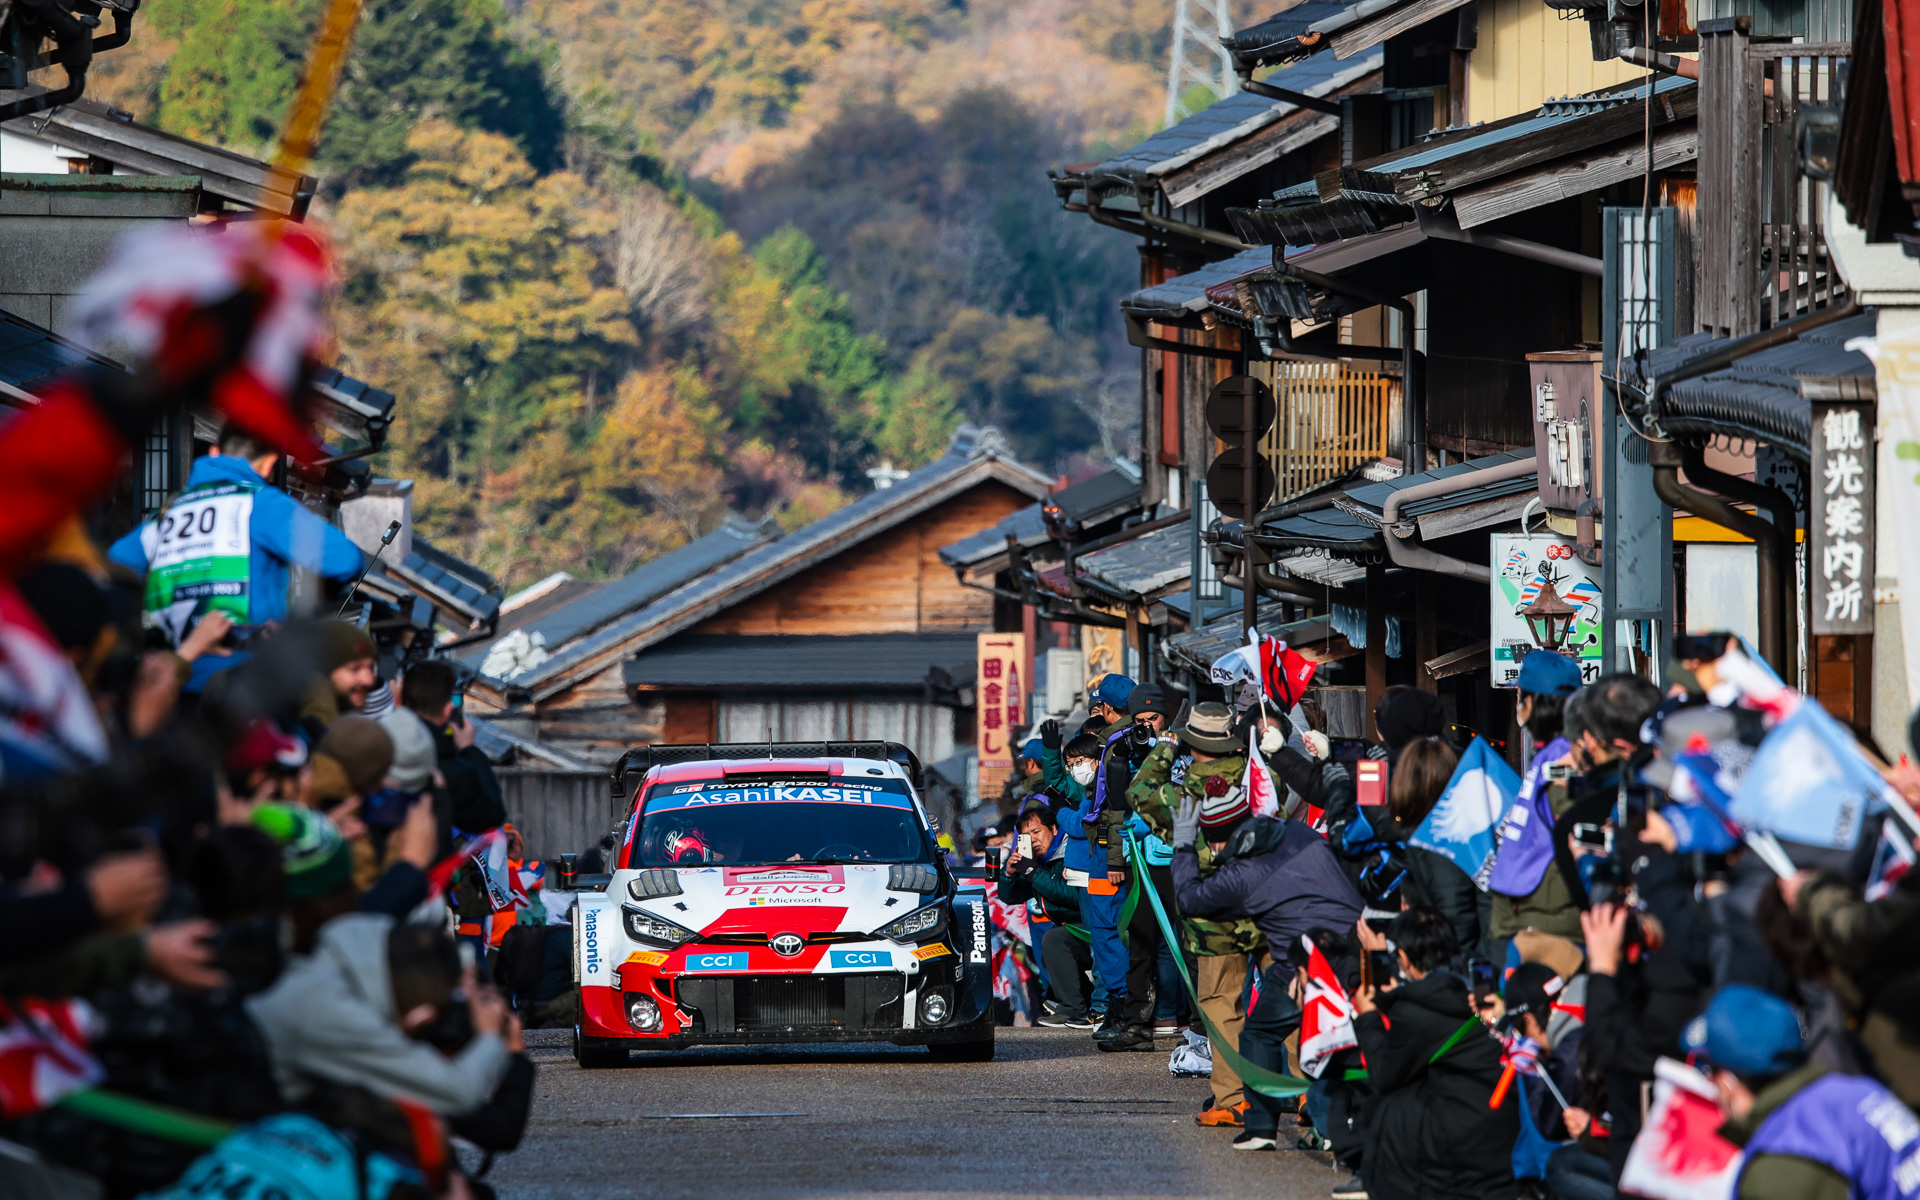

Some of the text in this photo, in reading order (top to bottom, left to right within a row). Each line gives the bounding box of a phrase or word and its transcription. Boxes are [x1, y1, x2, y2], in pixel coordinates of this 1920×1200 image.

[1823, 409, 1864, 622] 観光案内所
[161, 507, 216, 544] 220
[1547, 546, 1573, 557] 快適
[674, 784, 703, 794] GR
[707, 782, 770, 790] TOYOTA
[831, 782, 883, 791] Racing
[725, 885, 846, 896] DENSO
[585, 909, 602, 974] Panasonic
[916, 944, 947, 958] PIRELLI
[629, 952, 661, 964] PIRELLI
